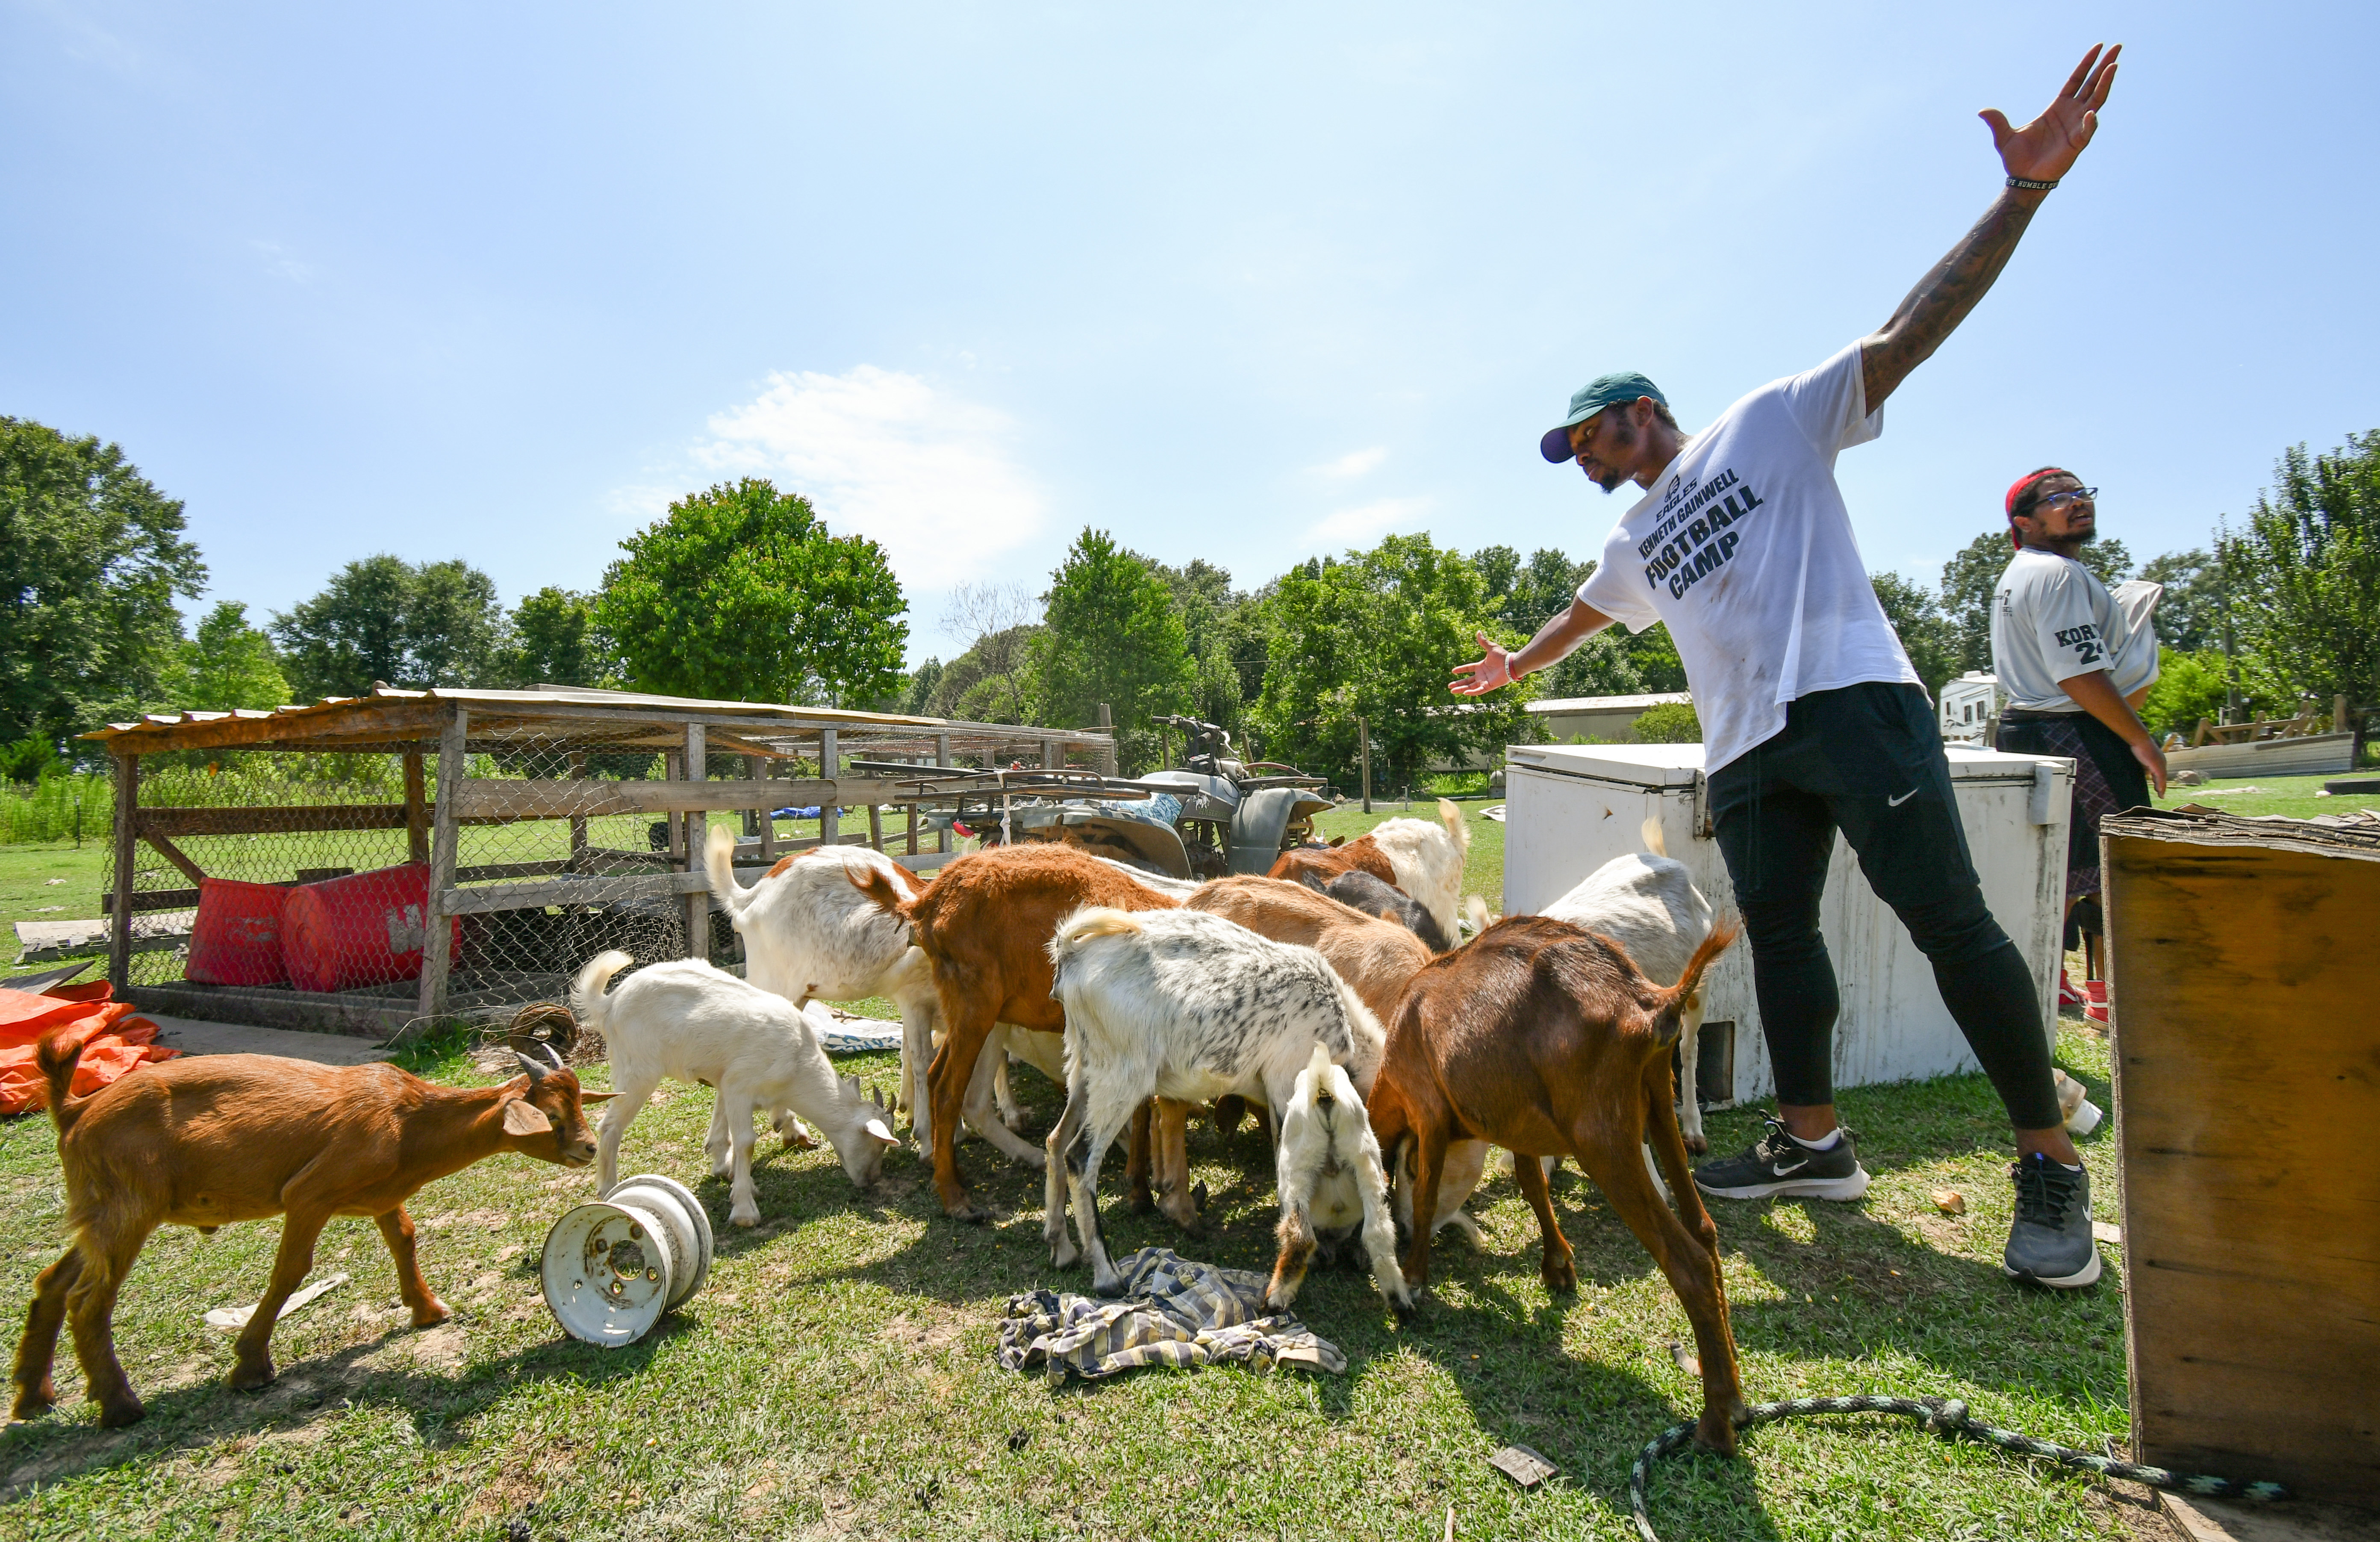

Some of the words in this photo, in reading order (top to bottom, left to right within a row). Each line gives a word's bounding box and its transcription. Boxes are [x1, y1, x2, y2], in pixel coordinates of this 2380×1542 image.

[2018, 181, 2047, 189] HUMBLE
[1638, 515, 1677, 561] KENNETH
[1677, 468, 1740, 523] GAINWELL
[1656, 477, 1697, 523] EAGLES
[1645, 485, 1764, 590] FOOTBALL
[1669, 531, 1739, 600] CAMP
